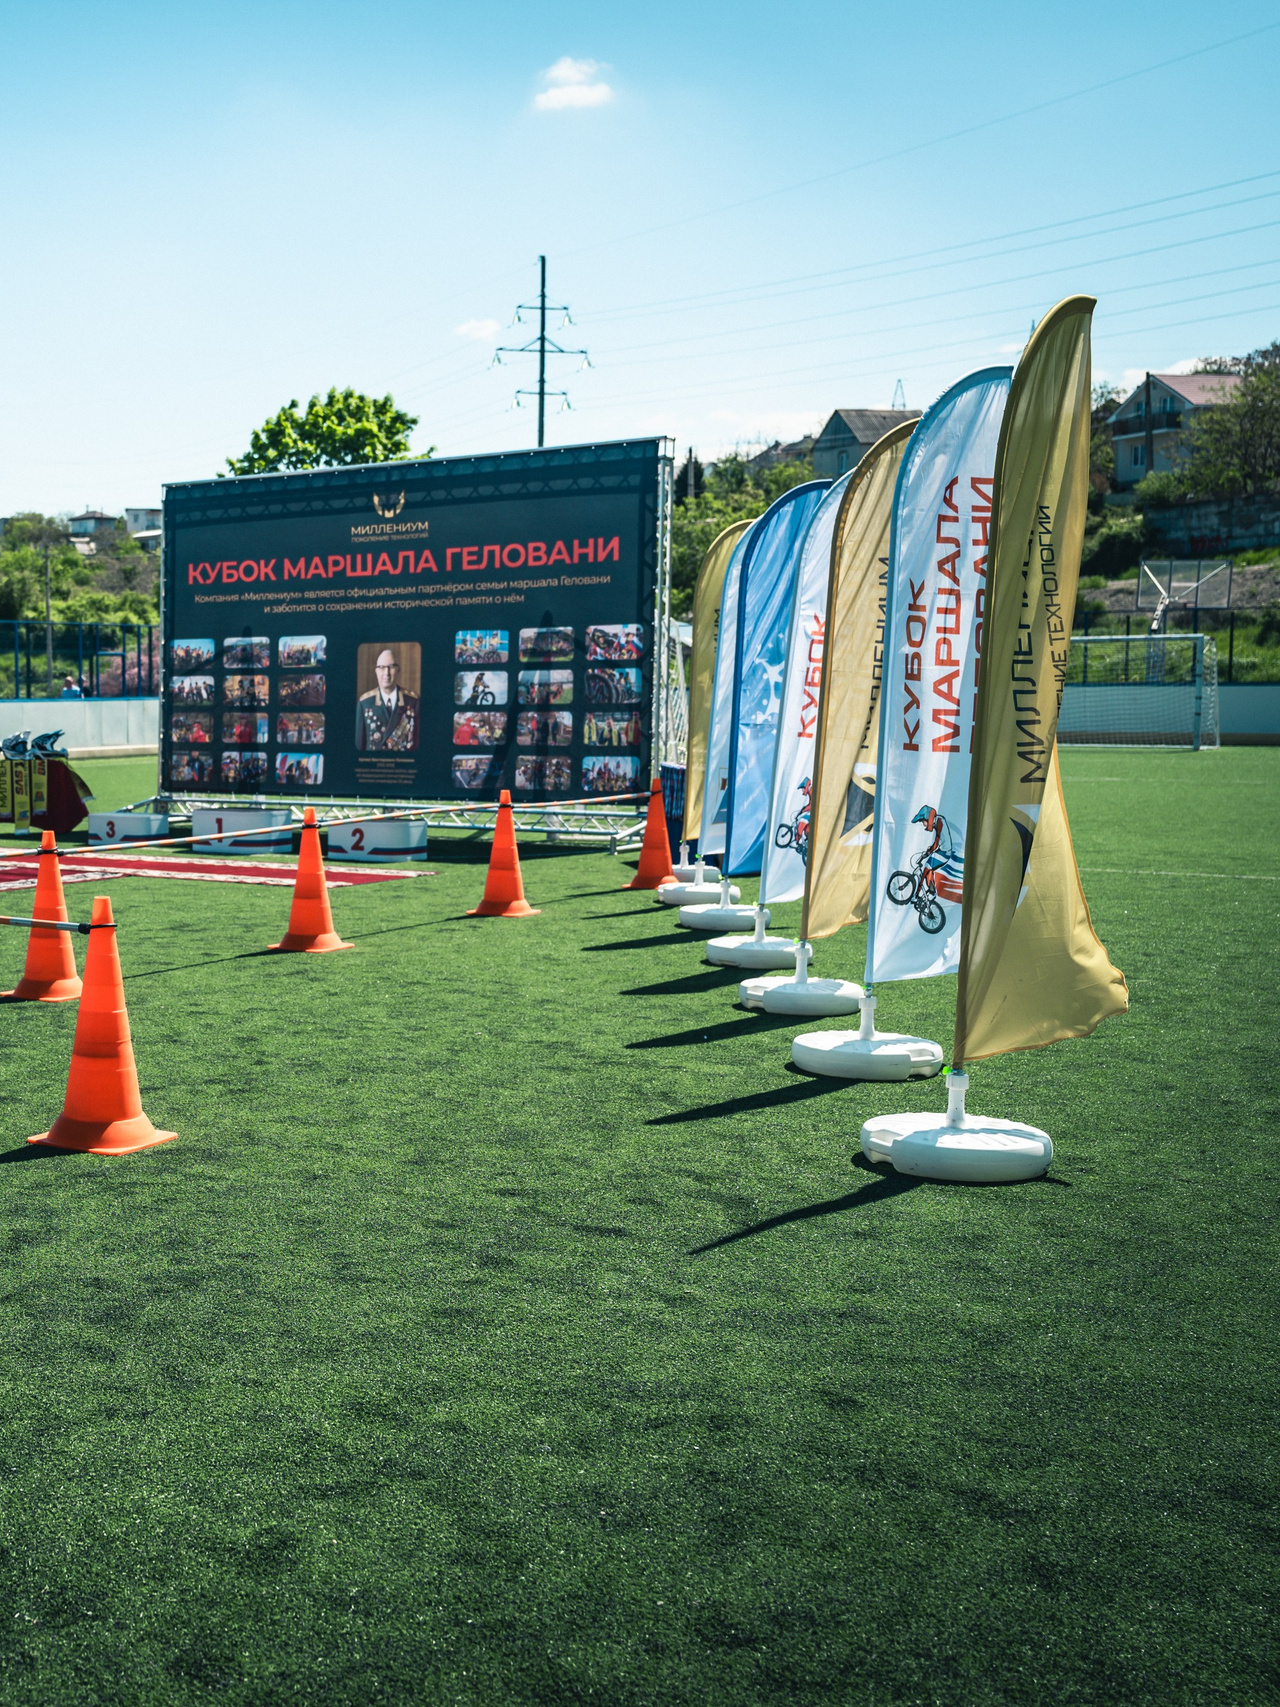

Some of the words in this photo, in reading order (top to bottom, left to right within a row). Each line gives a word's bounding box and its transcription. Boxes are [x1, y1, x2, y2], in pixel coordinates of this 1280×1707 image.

[351, 521, 429, 536] МИЛЛЕНИУМ
[188, 558, 277, 585] КУБОК
[283, 549, 439, 581] МАРШАЛА
[445, 536, 620, 572] ГЕЛОВАНИ
[1037, 504, 1065, 646] ТЕХНОЛОГИЙ
[194, 594, 239, 604] Компания
[240, 590, 302, 602] «Миллениум»
[304, 588, 344, 599] является
[346, 585, 415, 598] официальным
[417, 580, 474, 595] партнёром
[475, 579, 508, 590] семьи
[509, 577, 558, 591] маршала
[560, 574, 611, 586] Геловани
[263, 605, 270, 613] и
[271, 602, 316, 613] заботится
[317, 604, 324, 612] о
[325, 600, 383, 613] сохранении
[384, 595, 453, 609] исторической
[455, 594, 494, 605] памяти
[495, 596, 502, 604] о
[503, 592, 525, 604] нём
[931, 475, 962, 753] МАРШАЛА
[797, 612, 826, 739] КУБОК
[903, 577, 926, 752] КУБОК
[106, 820, 116, 838] 3
[215, 818, 223, 843] 1
[350, 828, 364, 851] 2
